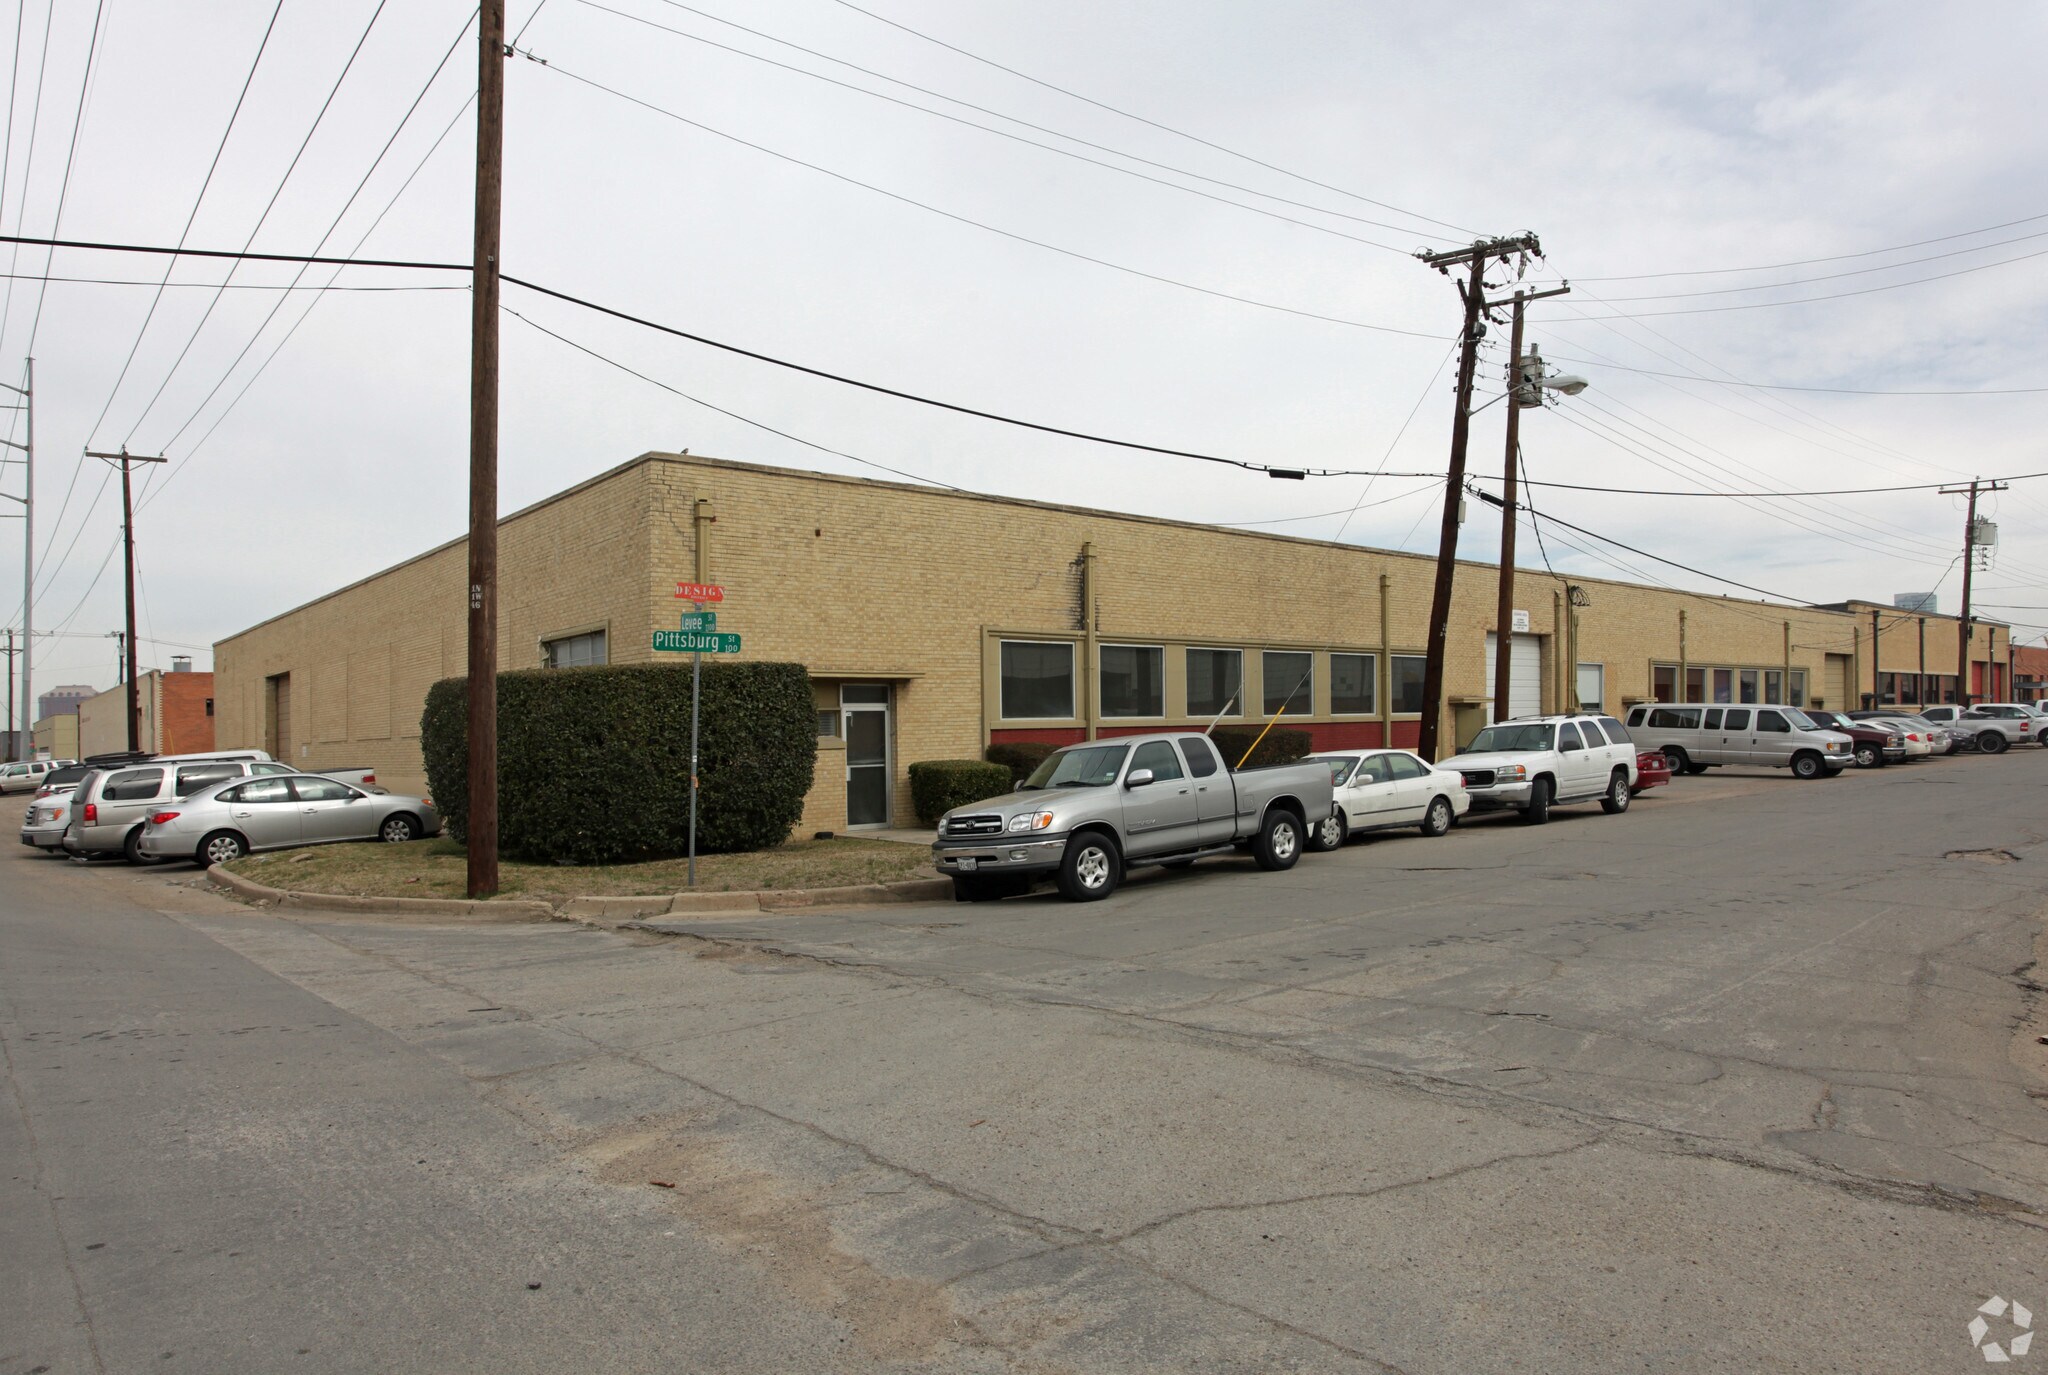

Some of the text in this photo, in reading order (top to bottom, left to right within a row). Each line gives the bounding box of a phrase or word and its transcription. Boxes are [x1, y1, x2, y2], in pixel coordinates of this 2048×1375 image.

[676, 586, 725, 597] DESIGN
[682, 615, 703, 630] Levee
[656, 632, 735, 652] Pittsburg St
[725, 645, 738, 653] 100
